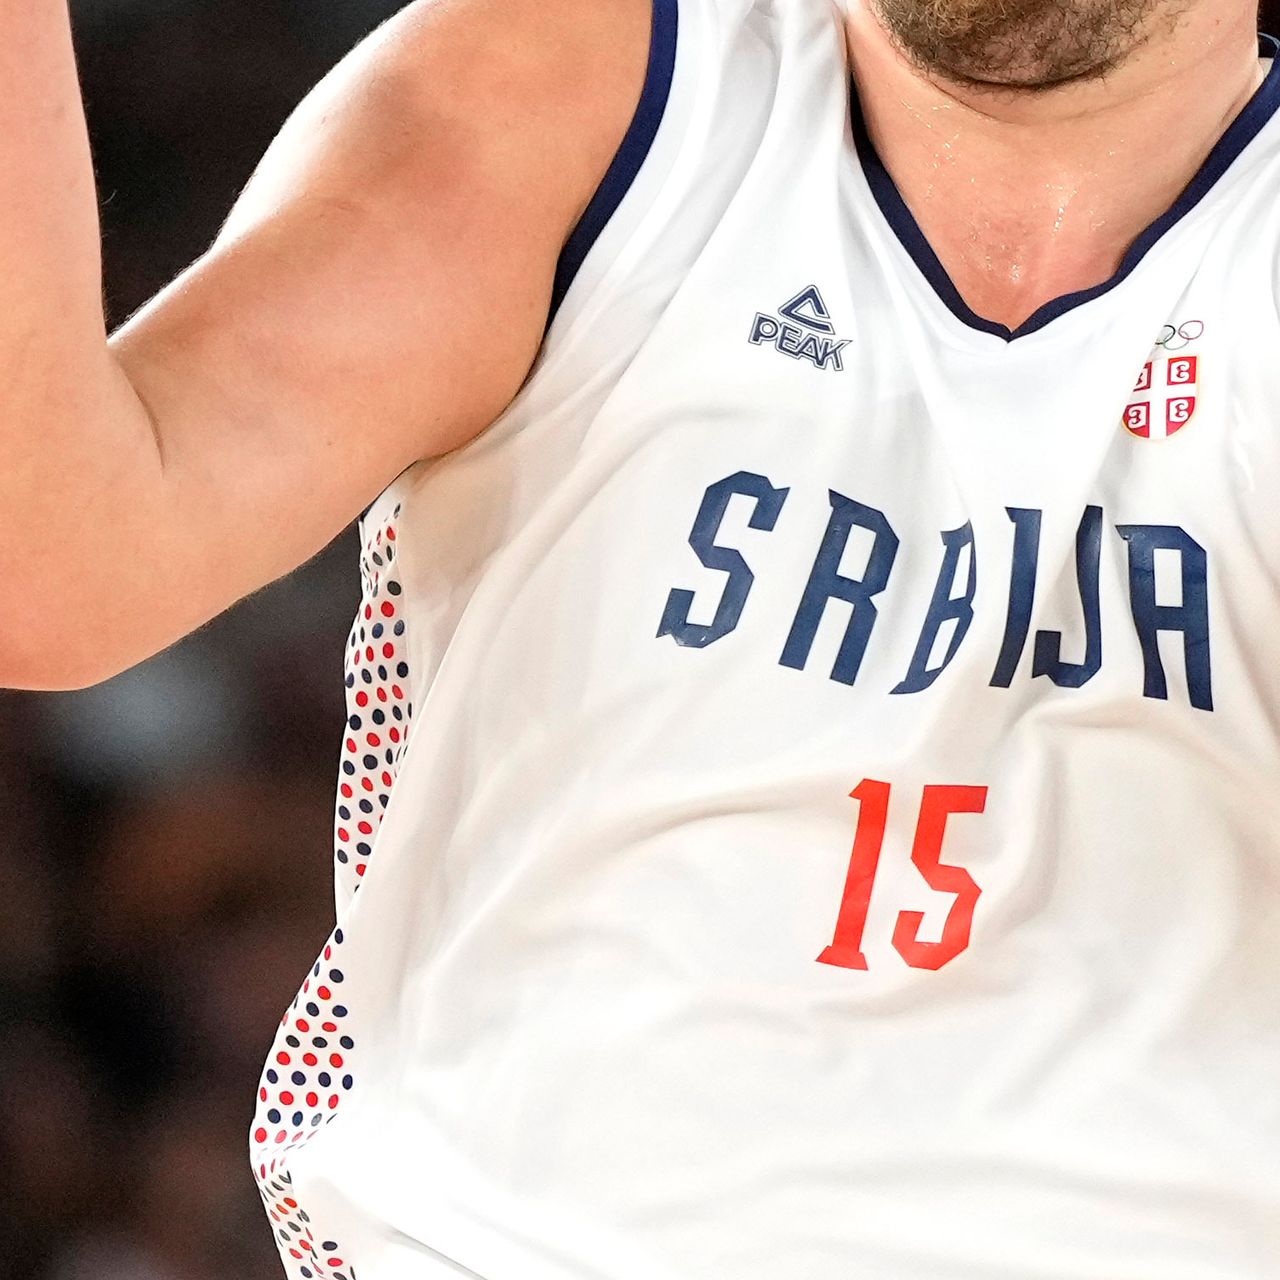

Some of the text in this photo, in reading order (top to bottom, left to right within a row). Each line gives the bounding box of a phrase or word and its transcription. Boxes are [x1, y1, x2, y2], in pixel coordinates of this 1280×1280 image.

[748, 312, 853, 371] PEAK
[656, 471, 1213, 711] SRBIJA
[815, 778, 988, 970] 15
